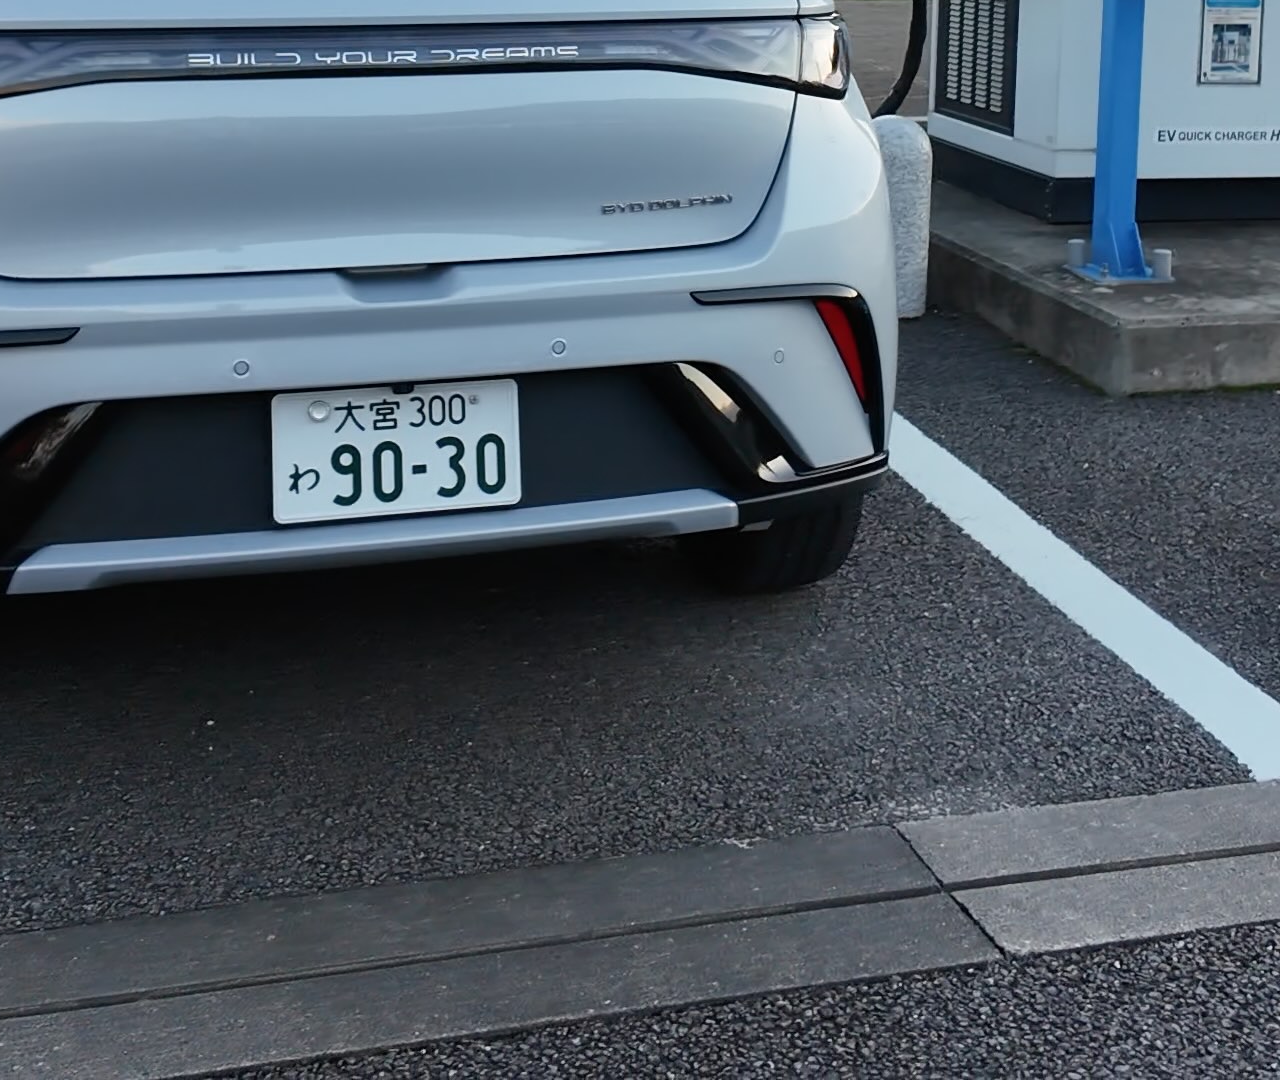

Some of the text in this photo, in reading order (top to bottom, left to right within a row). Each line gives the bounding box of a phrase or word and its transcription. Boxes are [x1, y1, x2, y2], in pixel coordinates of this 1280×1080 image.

[187, 45, 579, 66] BUILD YOUR DREAMS
[1157, 130, 1176, 142] EV
[1178, 131, 1211, 141] QUICK
[1214, 131, 1267, 141] CHARGER
[601, 193, 733, 216] BYD DOLPHIN
[334, 394, 466, 433] 大宮 300
[289, 433, 506, 507] わ 90-30
